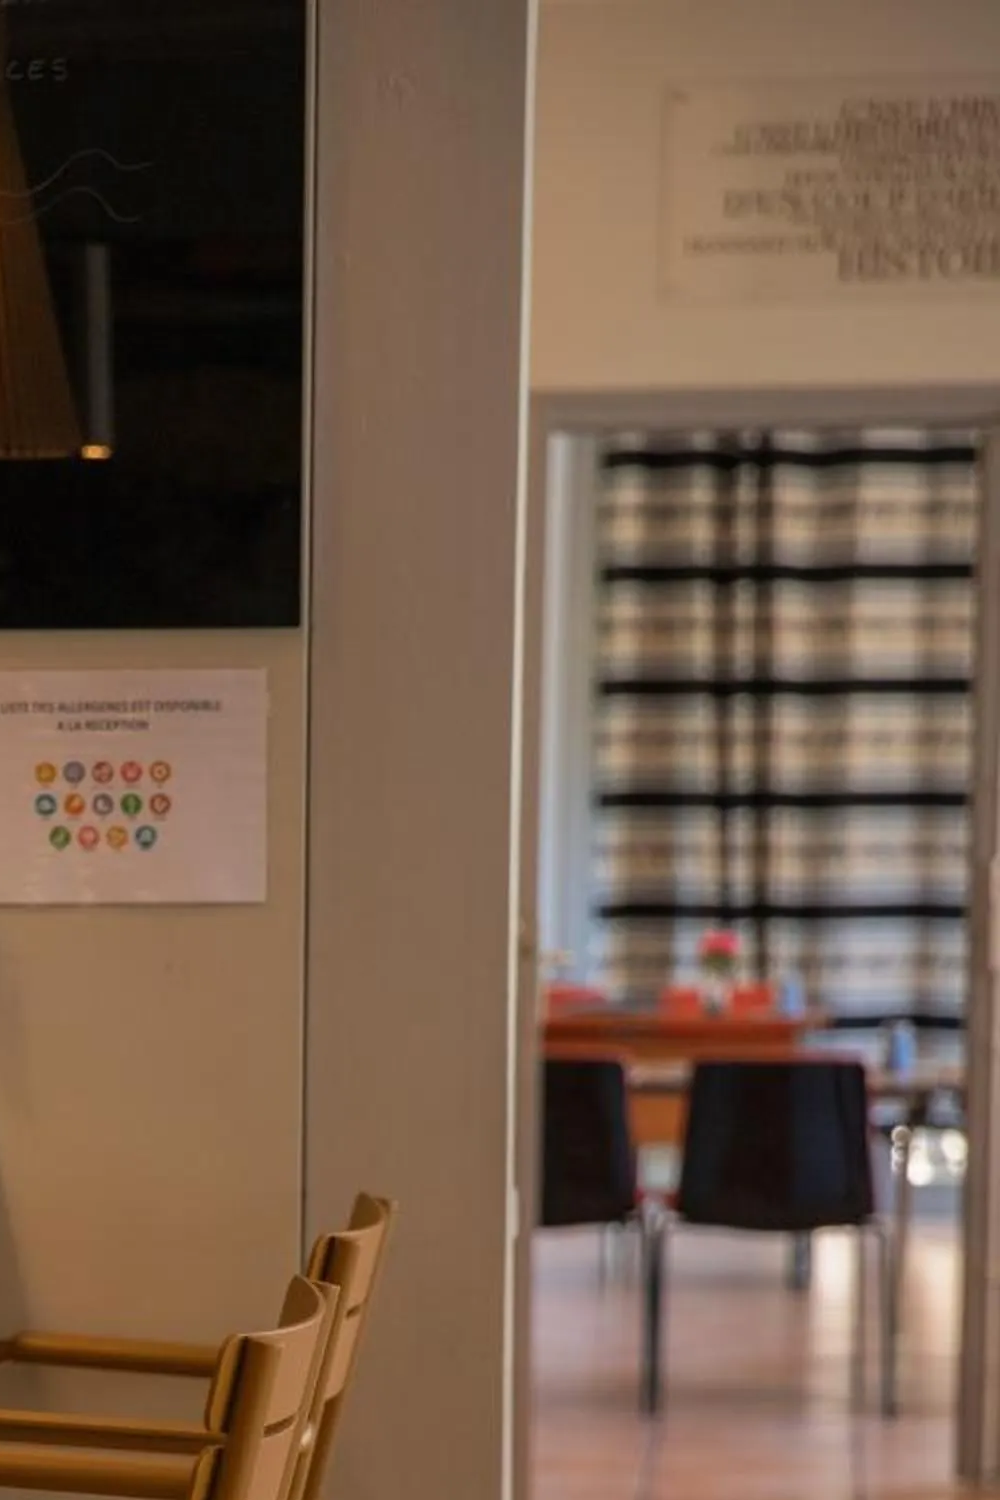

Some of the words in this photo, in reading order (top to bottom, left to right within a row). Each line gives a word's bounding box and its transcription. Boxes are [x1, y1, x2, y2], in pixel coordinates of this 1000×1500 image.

[1, 703, 29, 714] LISTE
[153, 700, 222, 712] DISPONIBLE
[69, 721, 82, 731] LA
[85, 720, 150, 731] RECEPTION
